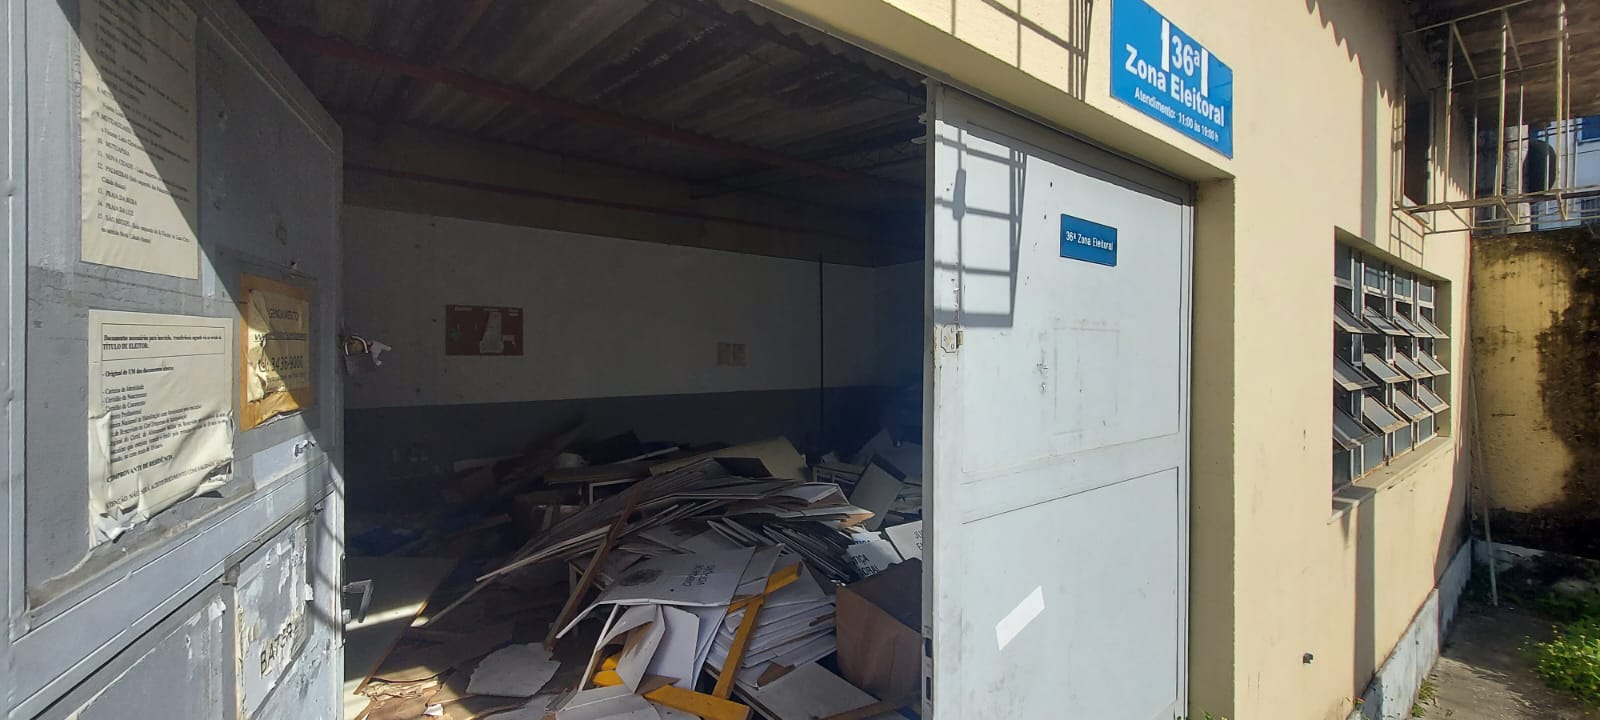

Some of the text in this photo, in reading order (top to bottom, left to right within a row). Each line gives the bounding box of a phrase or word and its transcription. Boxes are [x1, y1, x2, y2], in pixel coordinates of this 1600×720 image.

[1125, 43, 1225, 128] Zona Eleitoral
[1178, 111, 1194, 129] 11:00
[1077, 233, 1091, 246] Zona
[1092, 237, 1114, 251] Eleitoral
